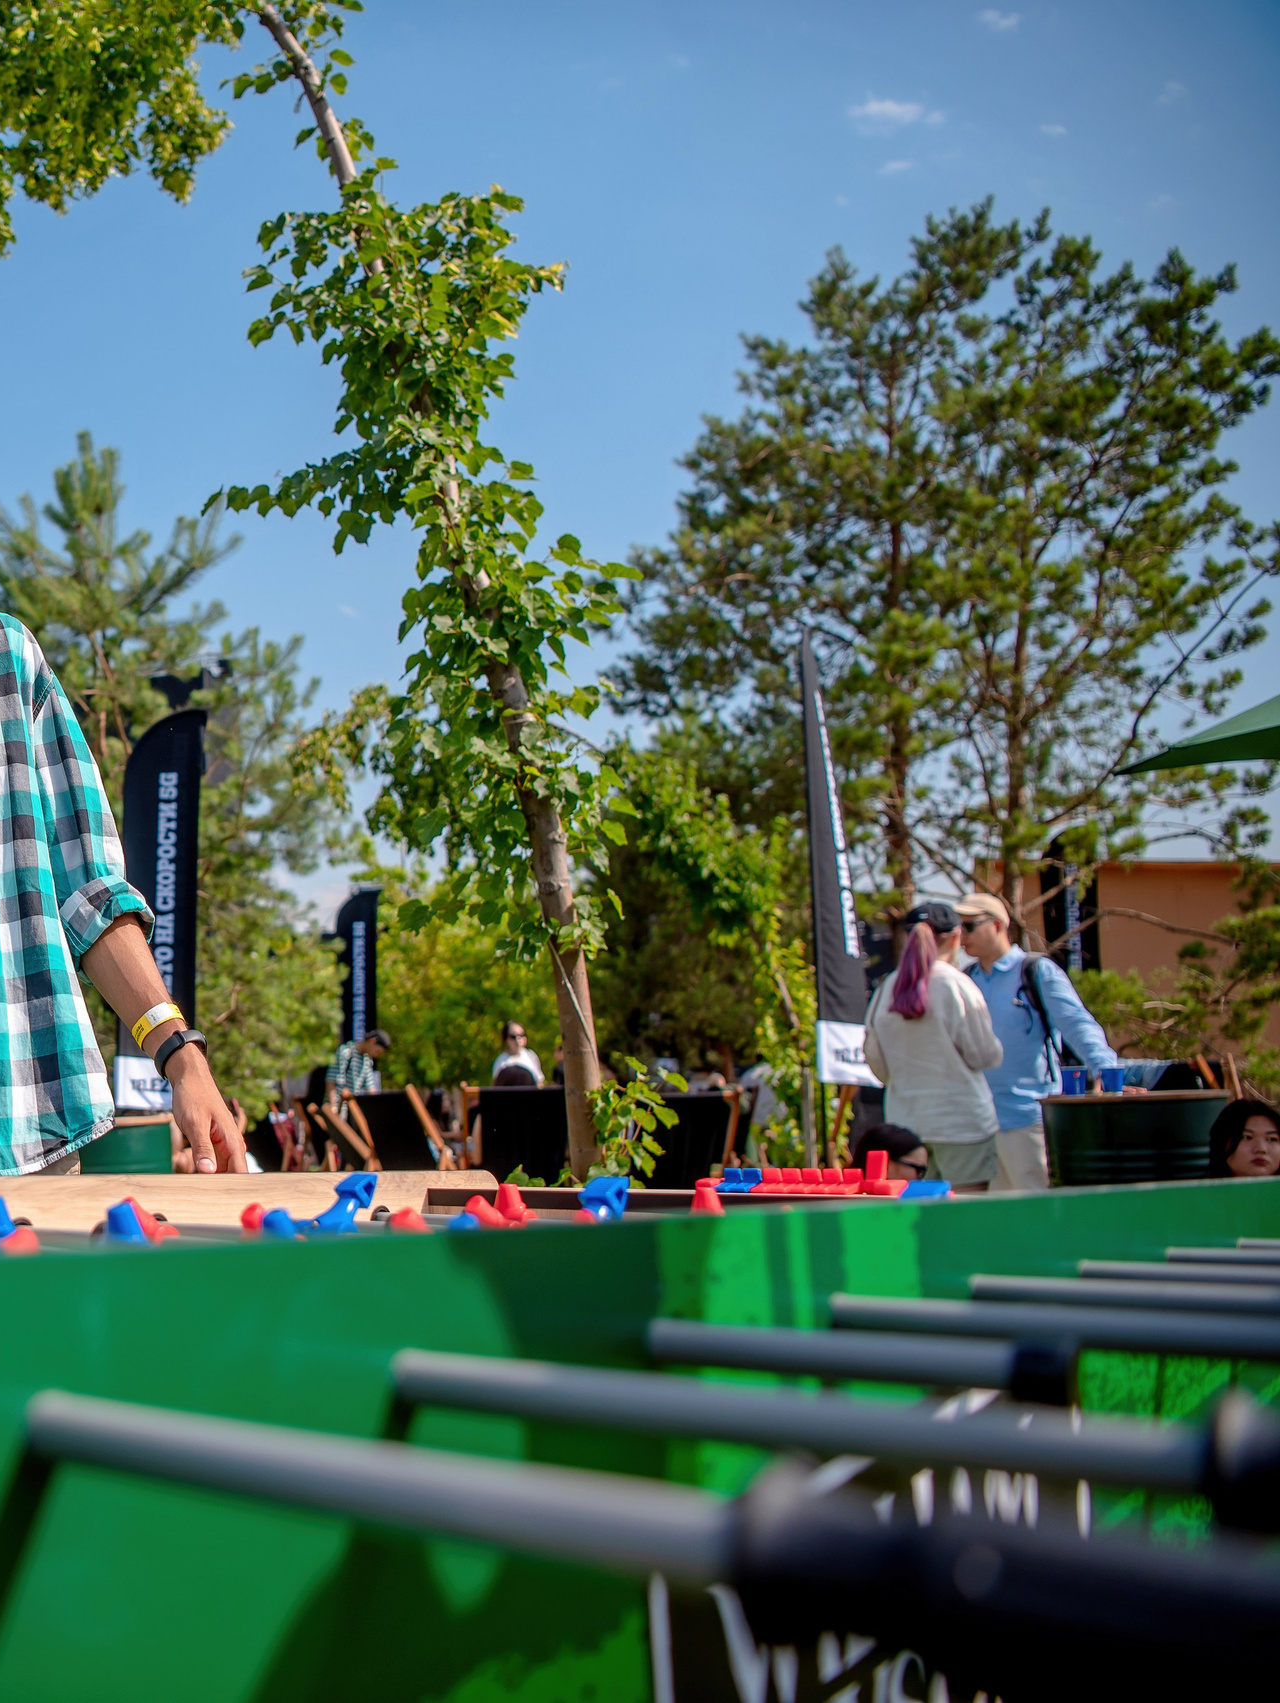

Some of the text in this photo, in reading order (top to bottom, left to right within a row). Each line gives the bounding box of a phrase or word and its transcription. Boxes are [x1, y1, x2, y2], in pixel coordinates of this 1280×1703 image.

[158, 772, 178, 800] 5G
[155, 802, 178, 912] СКОРОСТИ
[154, 912, 175, 945] НА
[833, 1047, 867, 1064] TELE
[130, 1077, 170, 1093] TELE2
